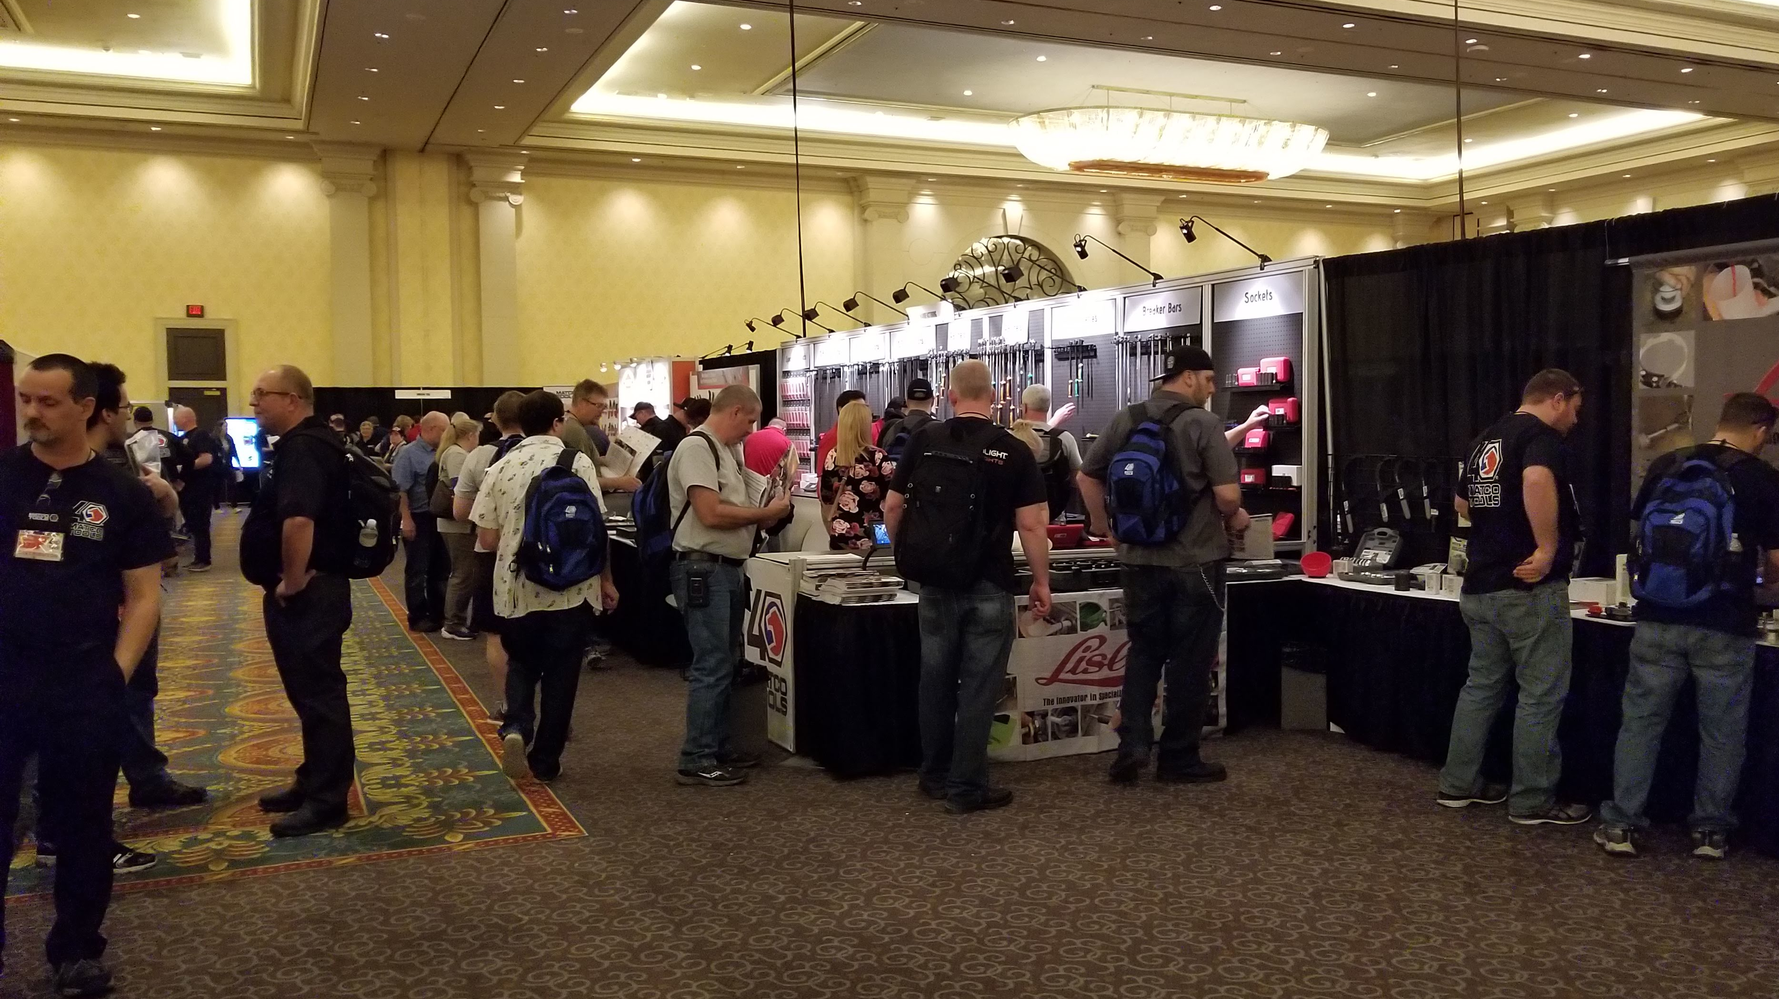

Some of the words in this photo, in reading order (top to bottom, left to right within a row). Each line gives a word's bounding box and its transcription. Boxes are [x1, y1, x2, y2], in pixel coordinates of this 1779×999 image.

[1244, 289, 1273, 304] Sockets
[1168, 302, 1182, 314] Bars
[1035, 634, 1132, 687] Lisl
[1043, 697, 1055, 707] The
